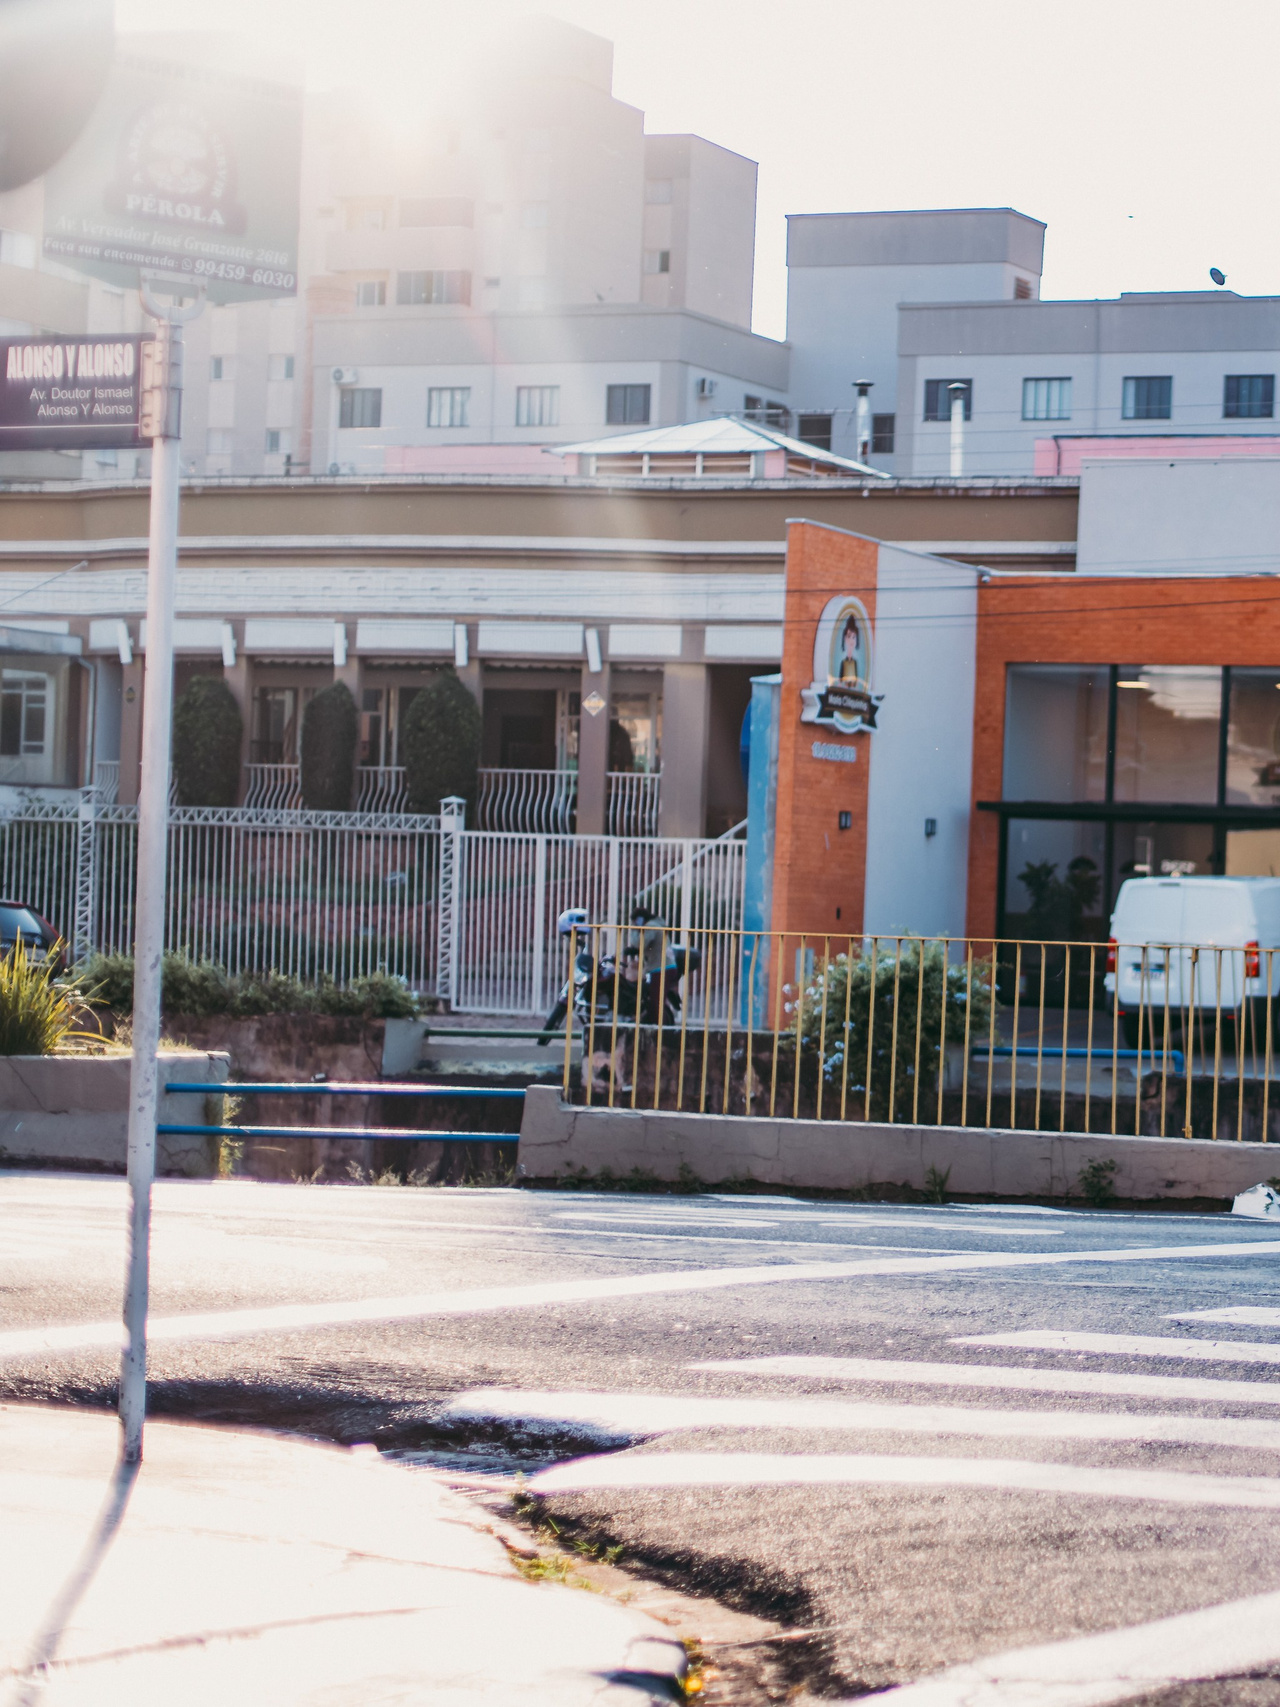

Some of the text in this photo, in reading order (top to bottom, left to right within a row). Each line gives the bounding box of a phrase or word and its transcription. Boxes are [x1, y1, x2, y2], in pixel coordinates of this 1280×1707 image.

[125, 193, 225, 226] PÉROLA
[81, 218, 150, 242] Vereador
[151, 230, 183, 248] José
[44, 237, 295, 289] Faça sua encomenda: 99459-6030
[7, 343, 134, 378] ALONSO Y ALONSO
[29, 386, 133, 399] Av. Doutor Ismael
[37, 402, 133, 416] Alonso Y Alonso
